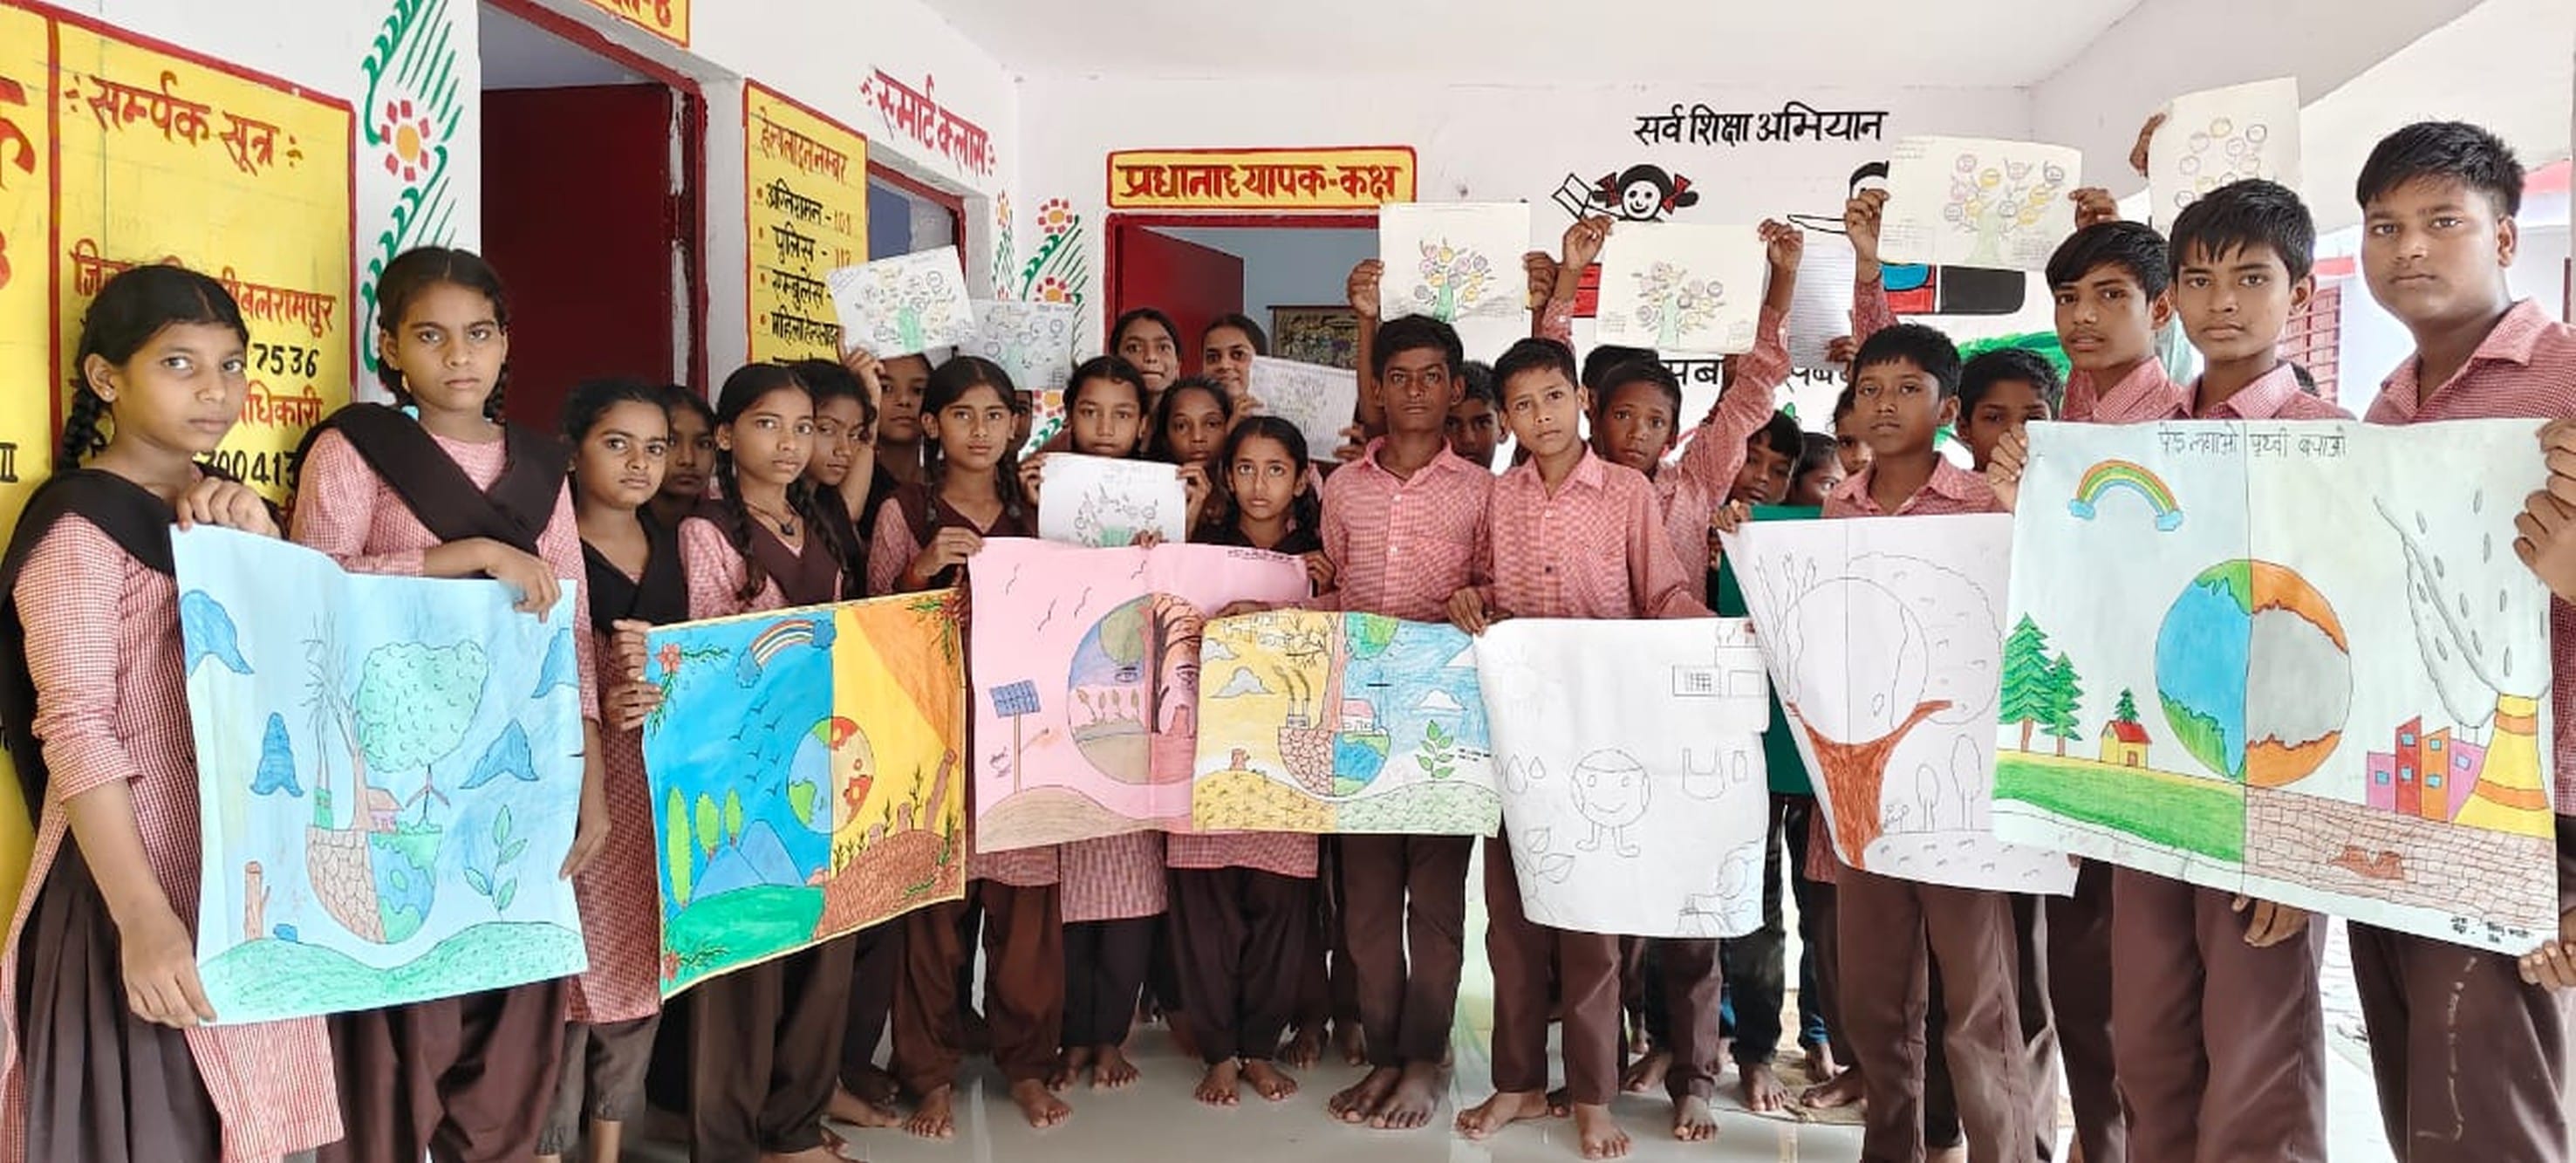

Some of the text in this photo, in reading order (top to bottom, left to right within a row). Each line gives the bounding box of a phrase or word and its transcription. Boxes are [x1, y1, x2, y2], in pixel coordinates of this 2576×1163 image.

[874, 68, 989, 178] स्मार्ट क्लास
[1634, 100, 1889, 147] सर्व शिक्षा अभियान
[770, 220, 817, 267] पुलिस
[244, 343, 319, 379] 7536
